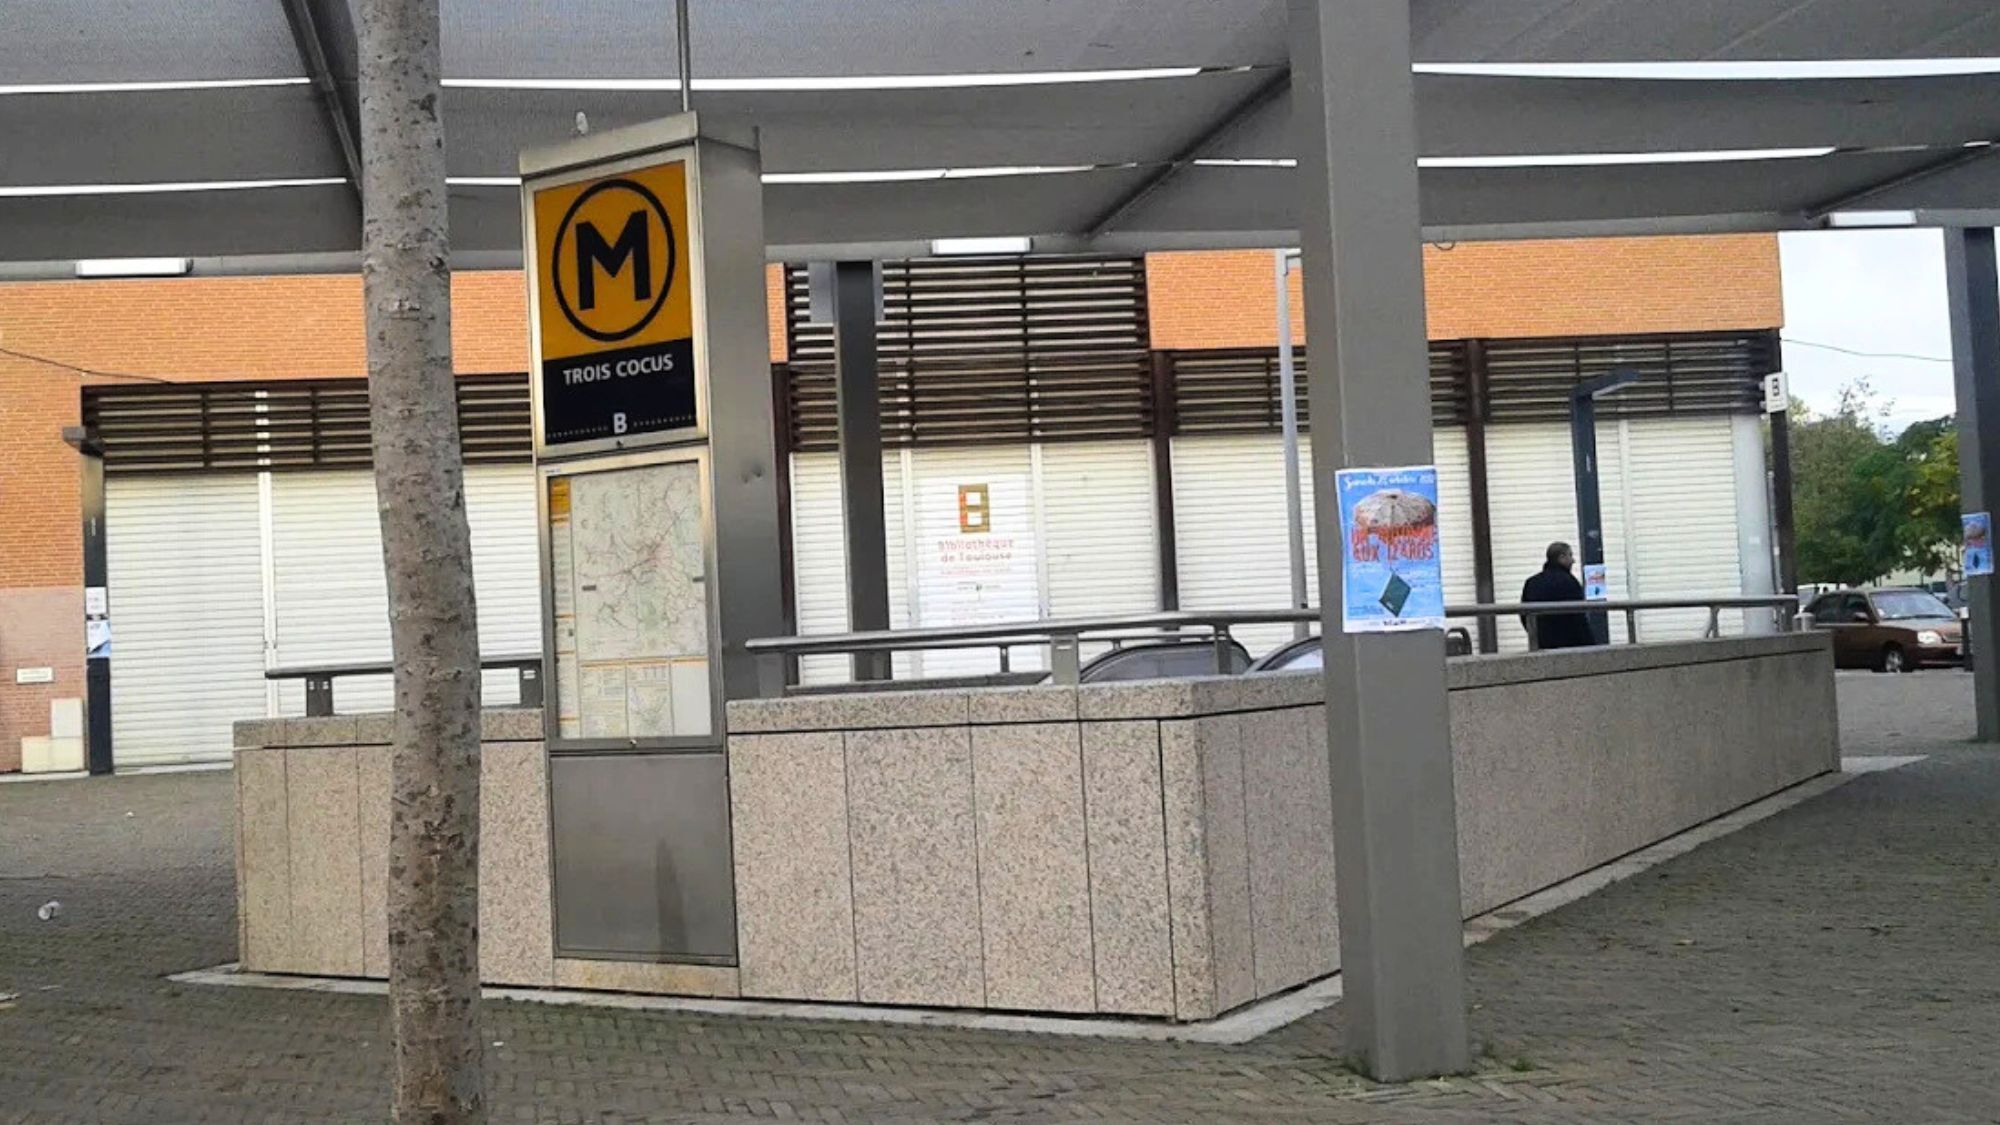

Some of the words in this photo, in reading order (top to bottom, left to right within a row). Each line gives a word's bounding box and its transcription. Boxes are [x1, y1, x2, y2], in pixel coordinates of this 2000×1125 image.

[575, 210, 652, 311] M
[563, 363, 611, 386] TROIS
[616, 354, 674, 377] COCUS
[612, 412, 627, 434] B
[941, 553, 955, 563] de
